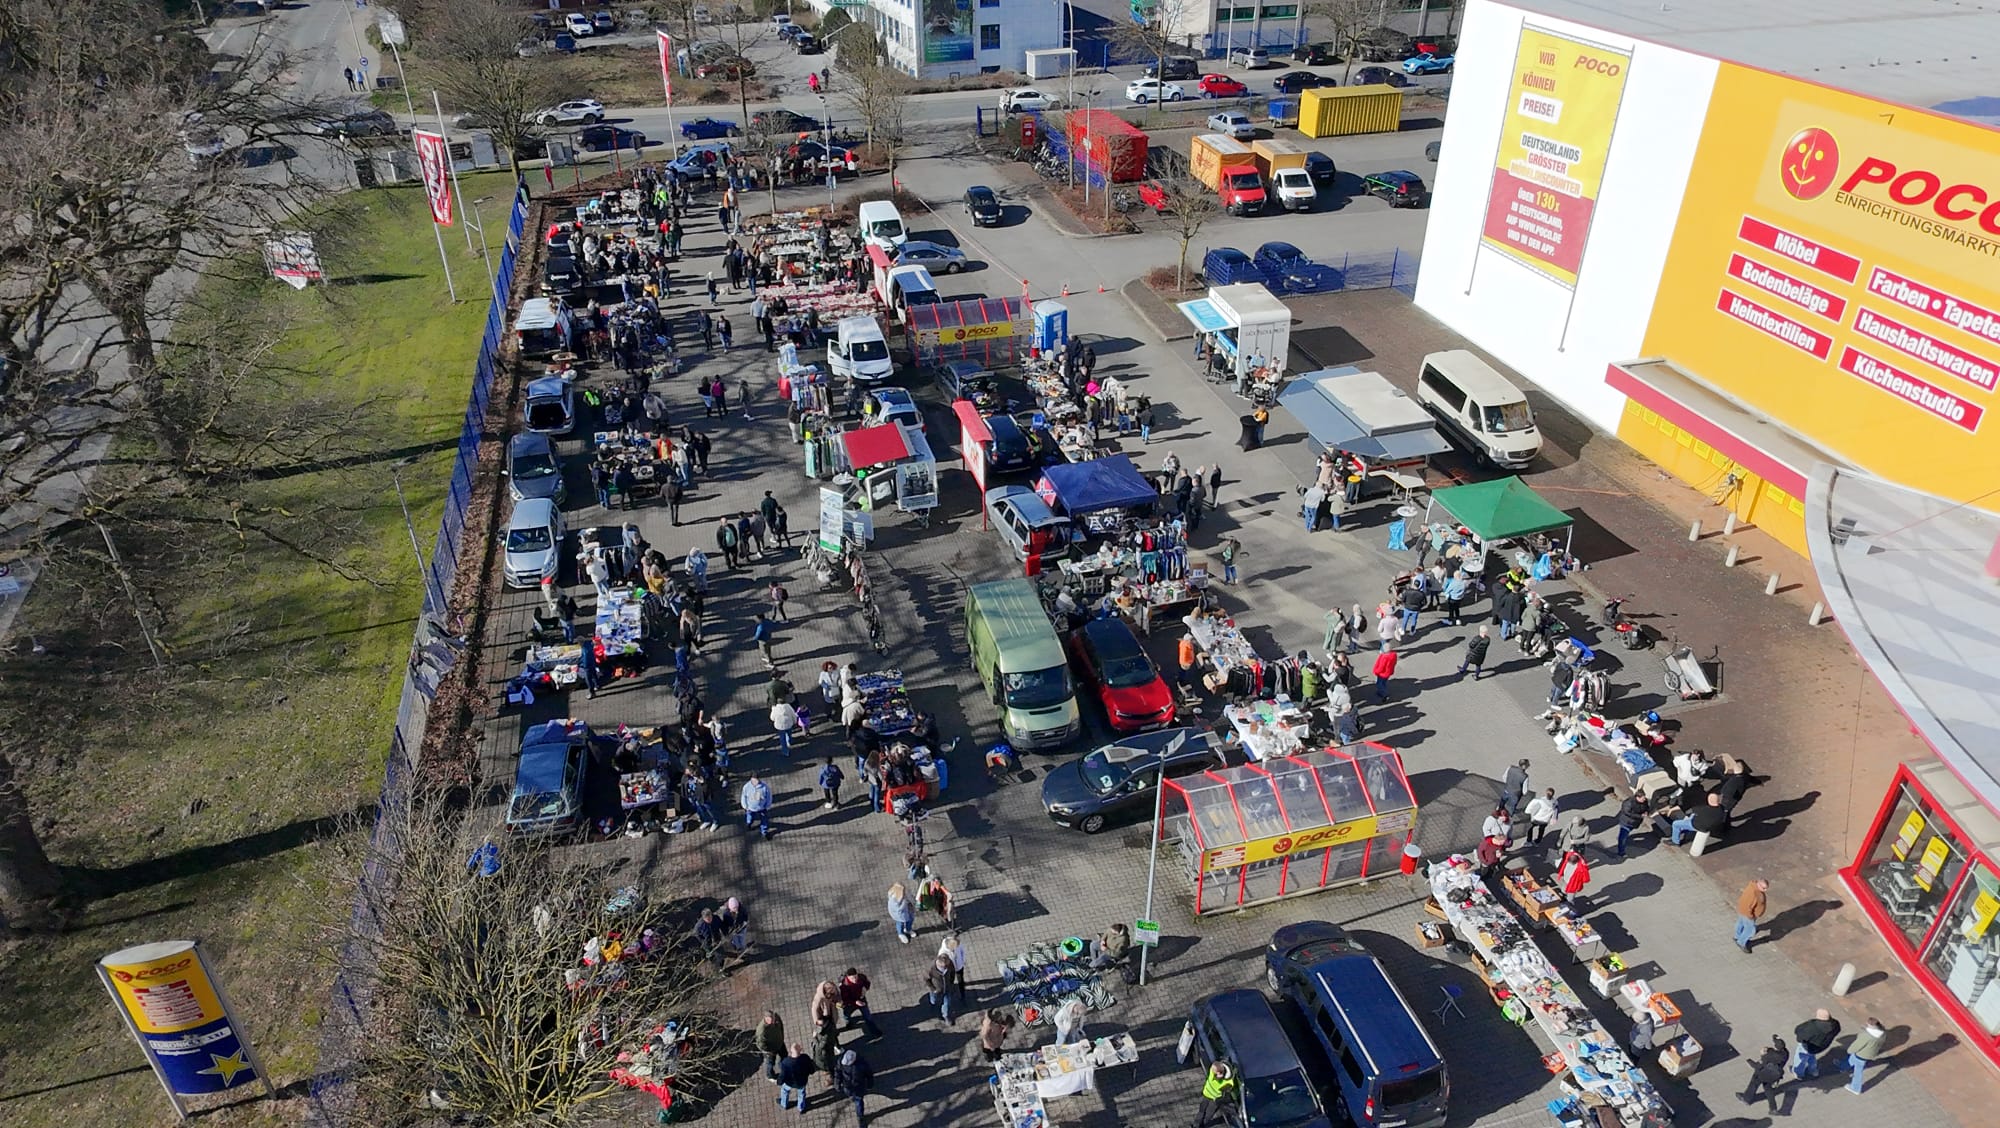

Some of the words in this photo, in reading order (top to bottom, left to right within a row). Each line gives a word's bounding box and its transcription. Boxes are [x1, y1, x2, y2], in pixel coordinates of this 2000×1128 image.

[1538, 50, 1556, 67] WIR
[1573, 55, 1620, 77] POCO
[1521, 71, 1556, 92] KÖNNEN
[1522, 98, 1556, 118] PREISE!
[1521, 134, 1581, 162] DEUTSCHLANDS
[1528, 152, 1567, 174] GRÖSSTER
[1834, 191, 2000, 258] EINRICHTUNGSMÄRKT
[1773, 232, 1819, 265] Möbel
[1741, 261, 1830, 313] Bodenbeläge
[1871, 271, 1930, 311] Farben
[1942, 298, 2000, 340] Tapete
[1729, 296, 1817, 351] Heimtextilien
[1858, 312, 1995, 387] Haushaltswaren
[1852, 354, 1966, 422] Küchenstudio
[1294, 826, 1353, 847] POCO
[135, 958, 191, 980] POCO
